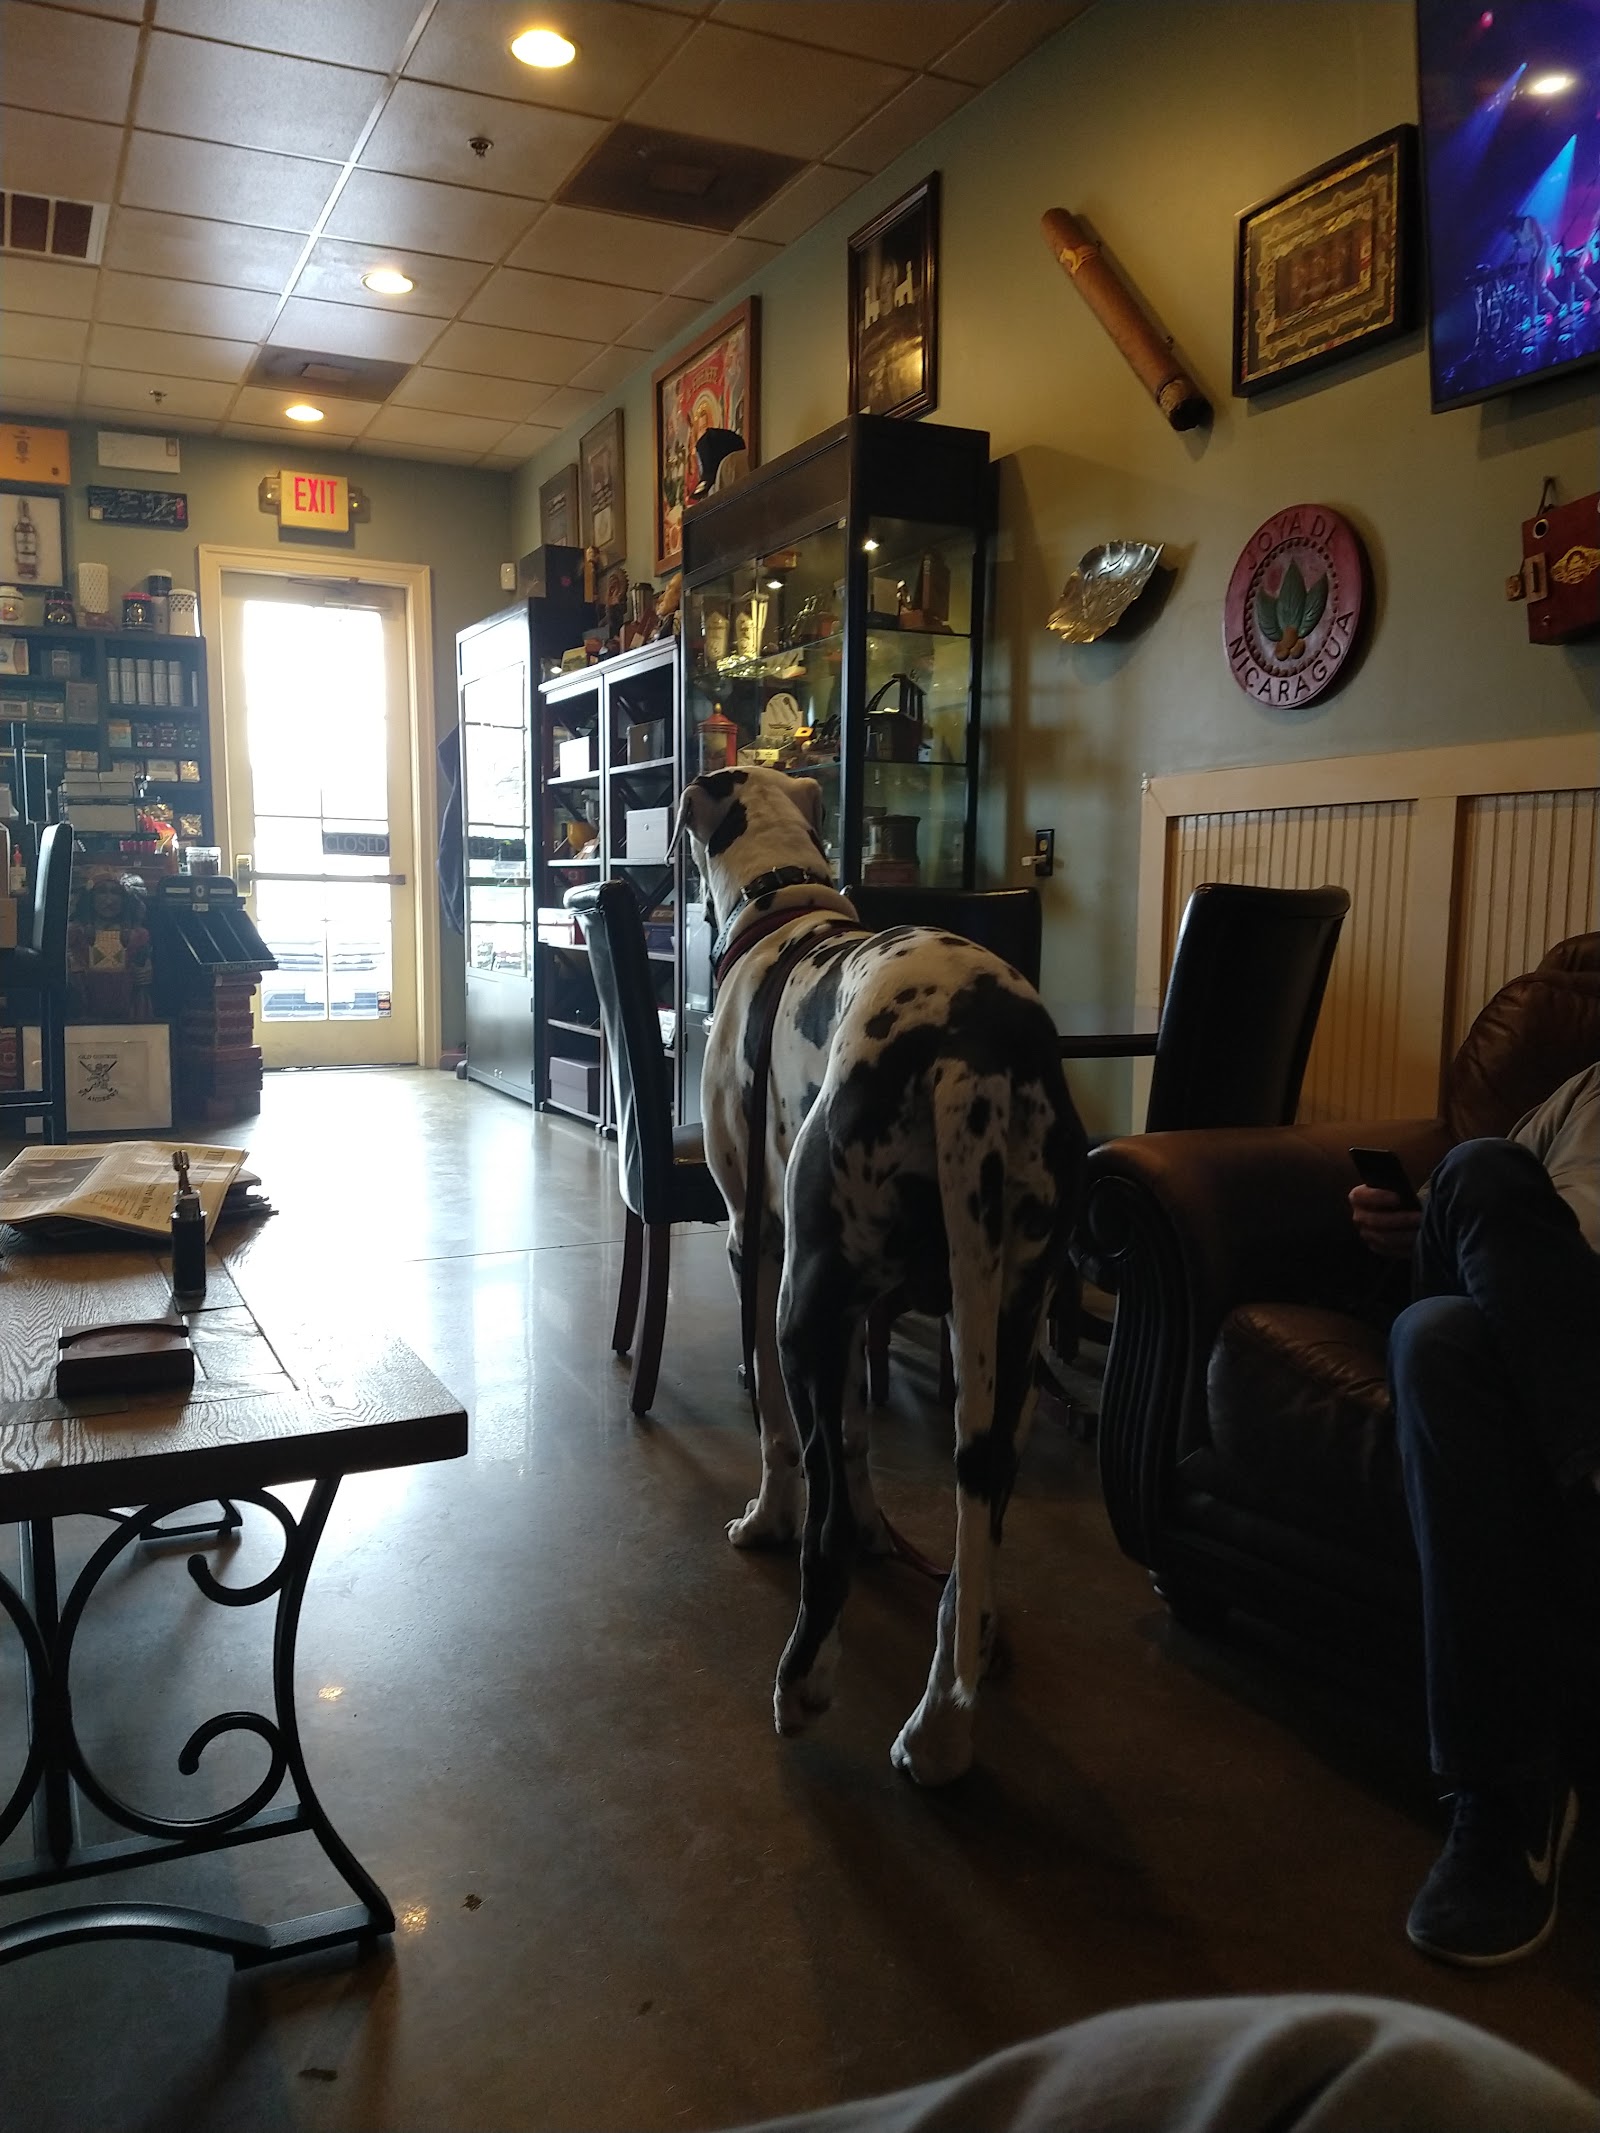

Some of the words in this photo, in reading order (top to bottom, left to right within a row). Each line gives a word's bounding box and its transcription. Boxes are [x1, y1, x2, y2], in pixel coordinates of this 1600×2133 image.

[295, 477, 337, 514] EXIT
[1247, 511, 1303, 571] JOYA
[1228, 610, 1355, 703] NICARAGUA
[324, 835, 388, 853] CLOSED
